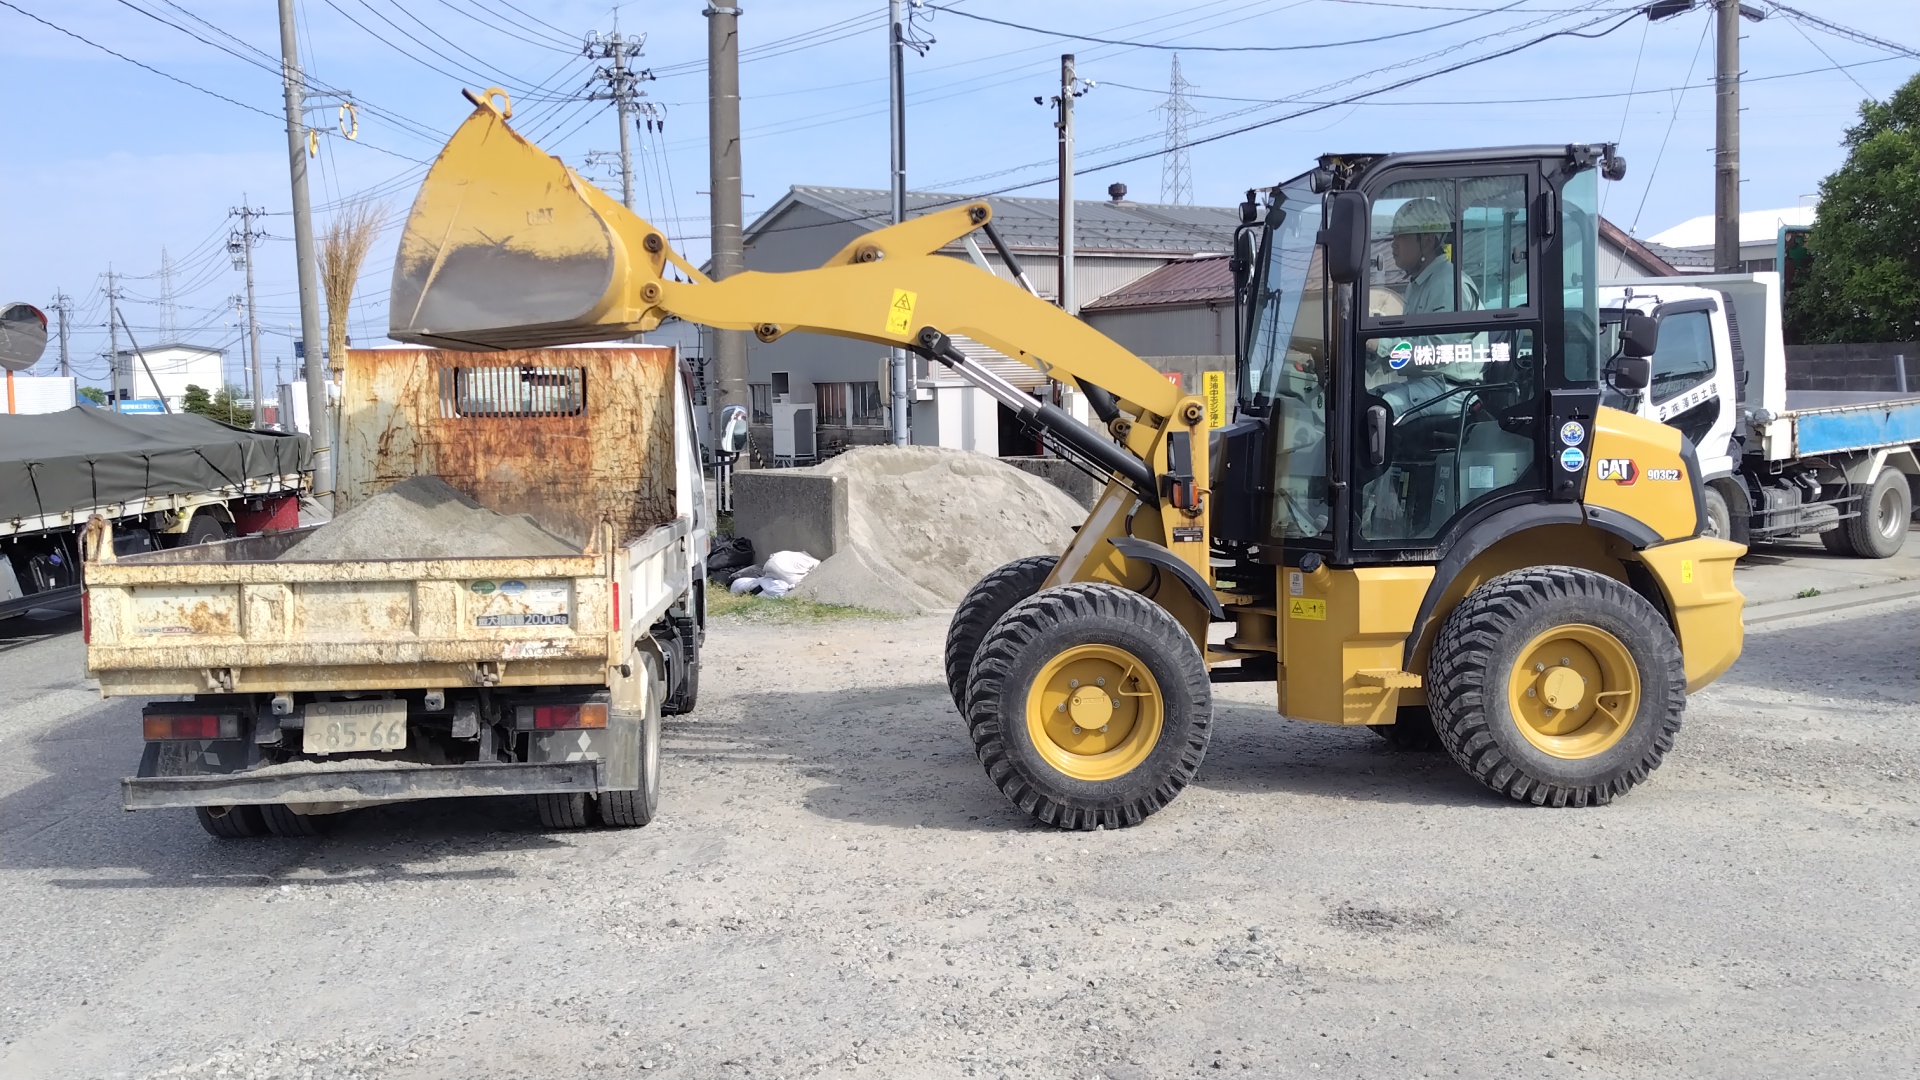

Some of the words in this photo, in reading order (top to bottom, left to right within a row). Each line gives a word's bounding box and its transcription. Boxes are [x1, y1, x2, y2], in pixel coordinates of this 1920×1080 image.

[1598, 459, 1630, 480] CAT
[1647, 469, 1679, 480] 903C2
[358, 704, 384, 718] 400
[326, 720, 401, 748] 85-66
